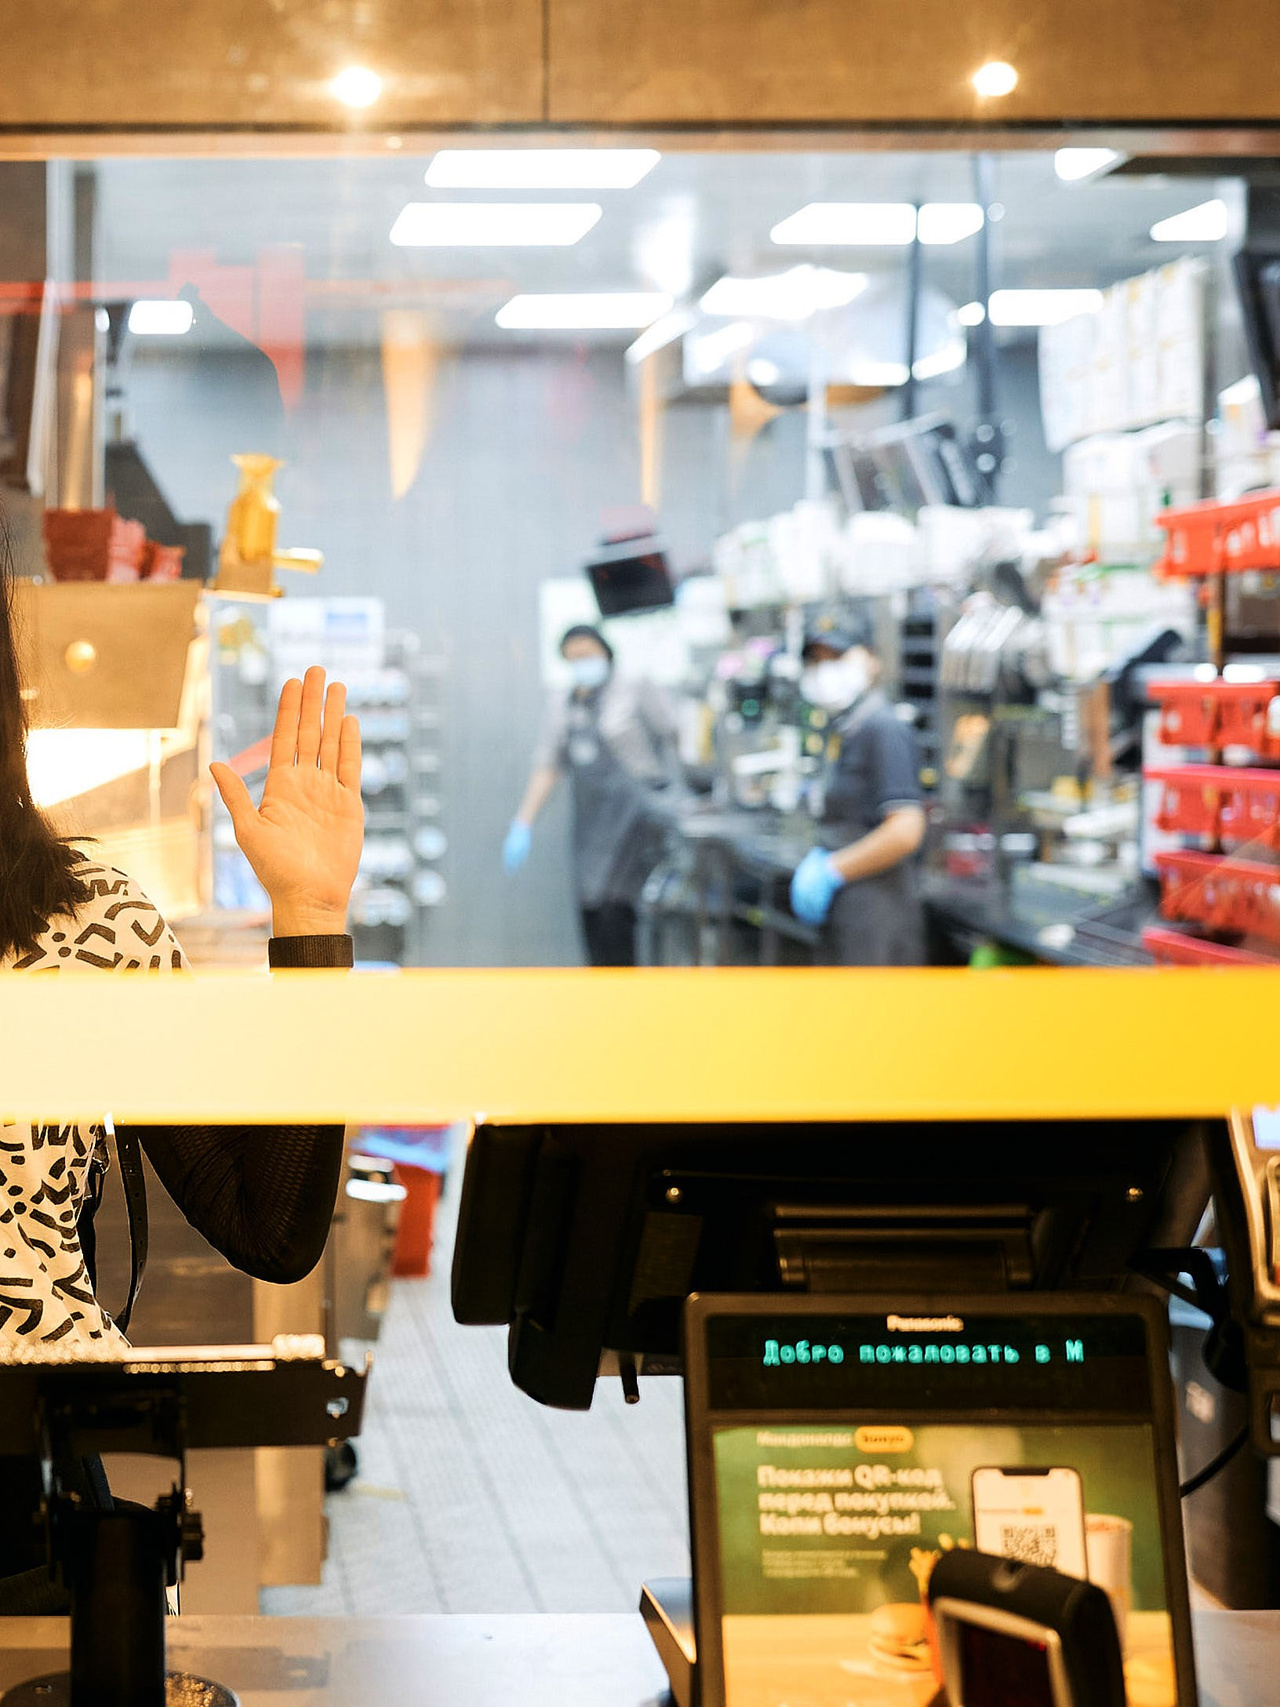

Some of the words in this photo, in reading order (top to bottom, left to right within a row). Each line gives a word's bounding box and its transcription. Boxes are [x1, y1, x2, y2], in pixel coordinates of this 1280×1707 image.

[886, 1314, 964, 1332] Panasonic
[763, 1339, 844, 1367] Добро
[859, 1344, 1020, 1364] пожаловать
[1035, 1344, 1051, 1364] в
[1065, 1339, 1084, 1363] М
[757, 1465, 854, 1488] Покажи
[758, 1492, 834, 1515] перед
